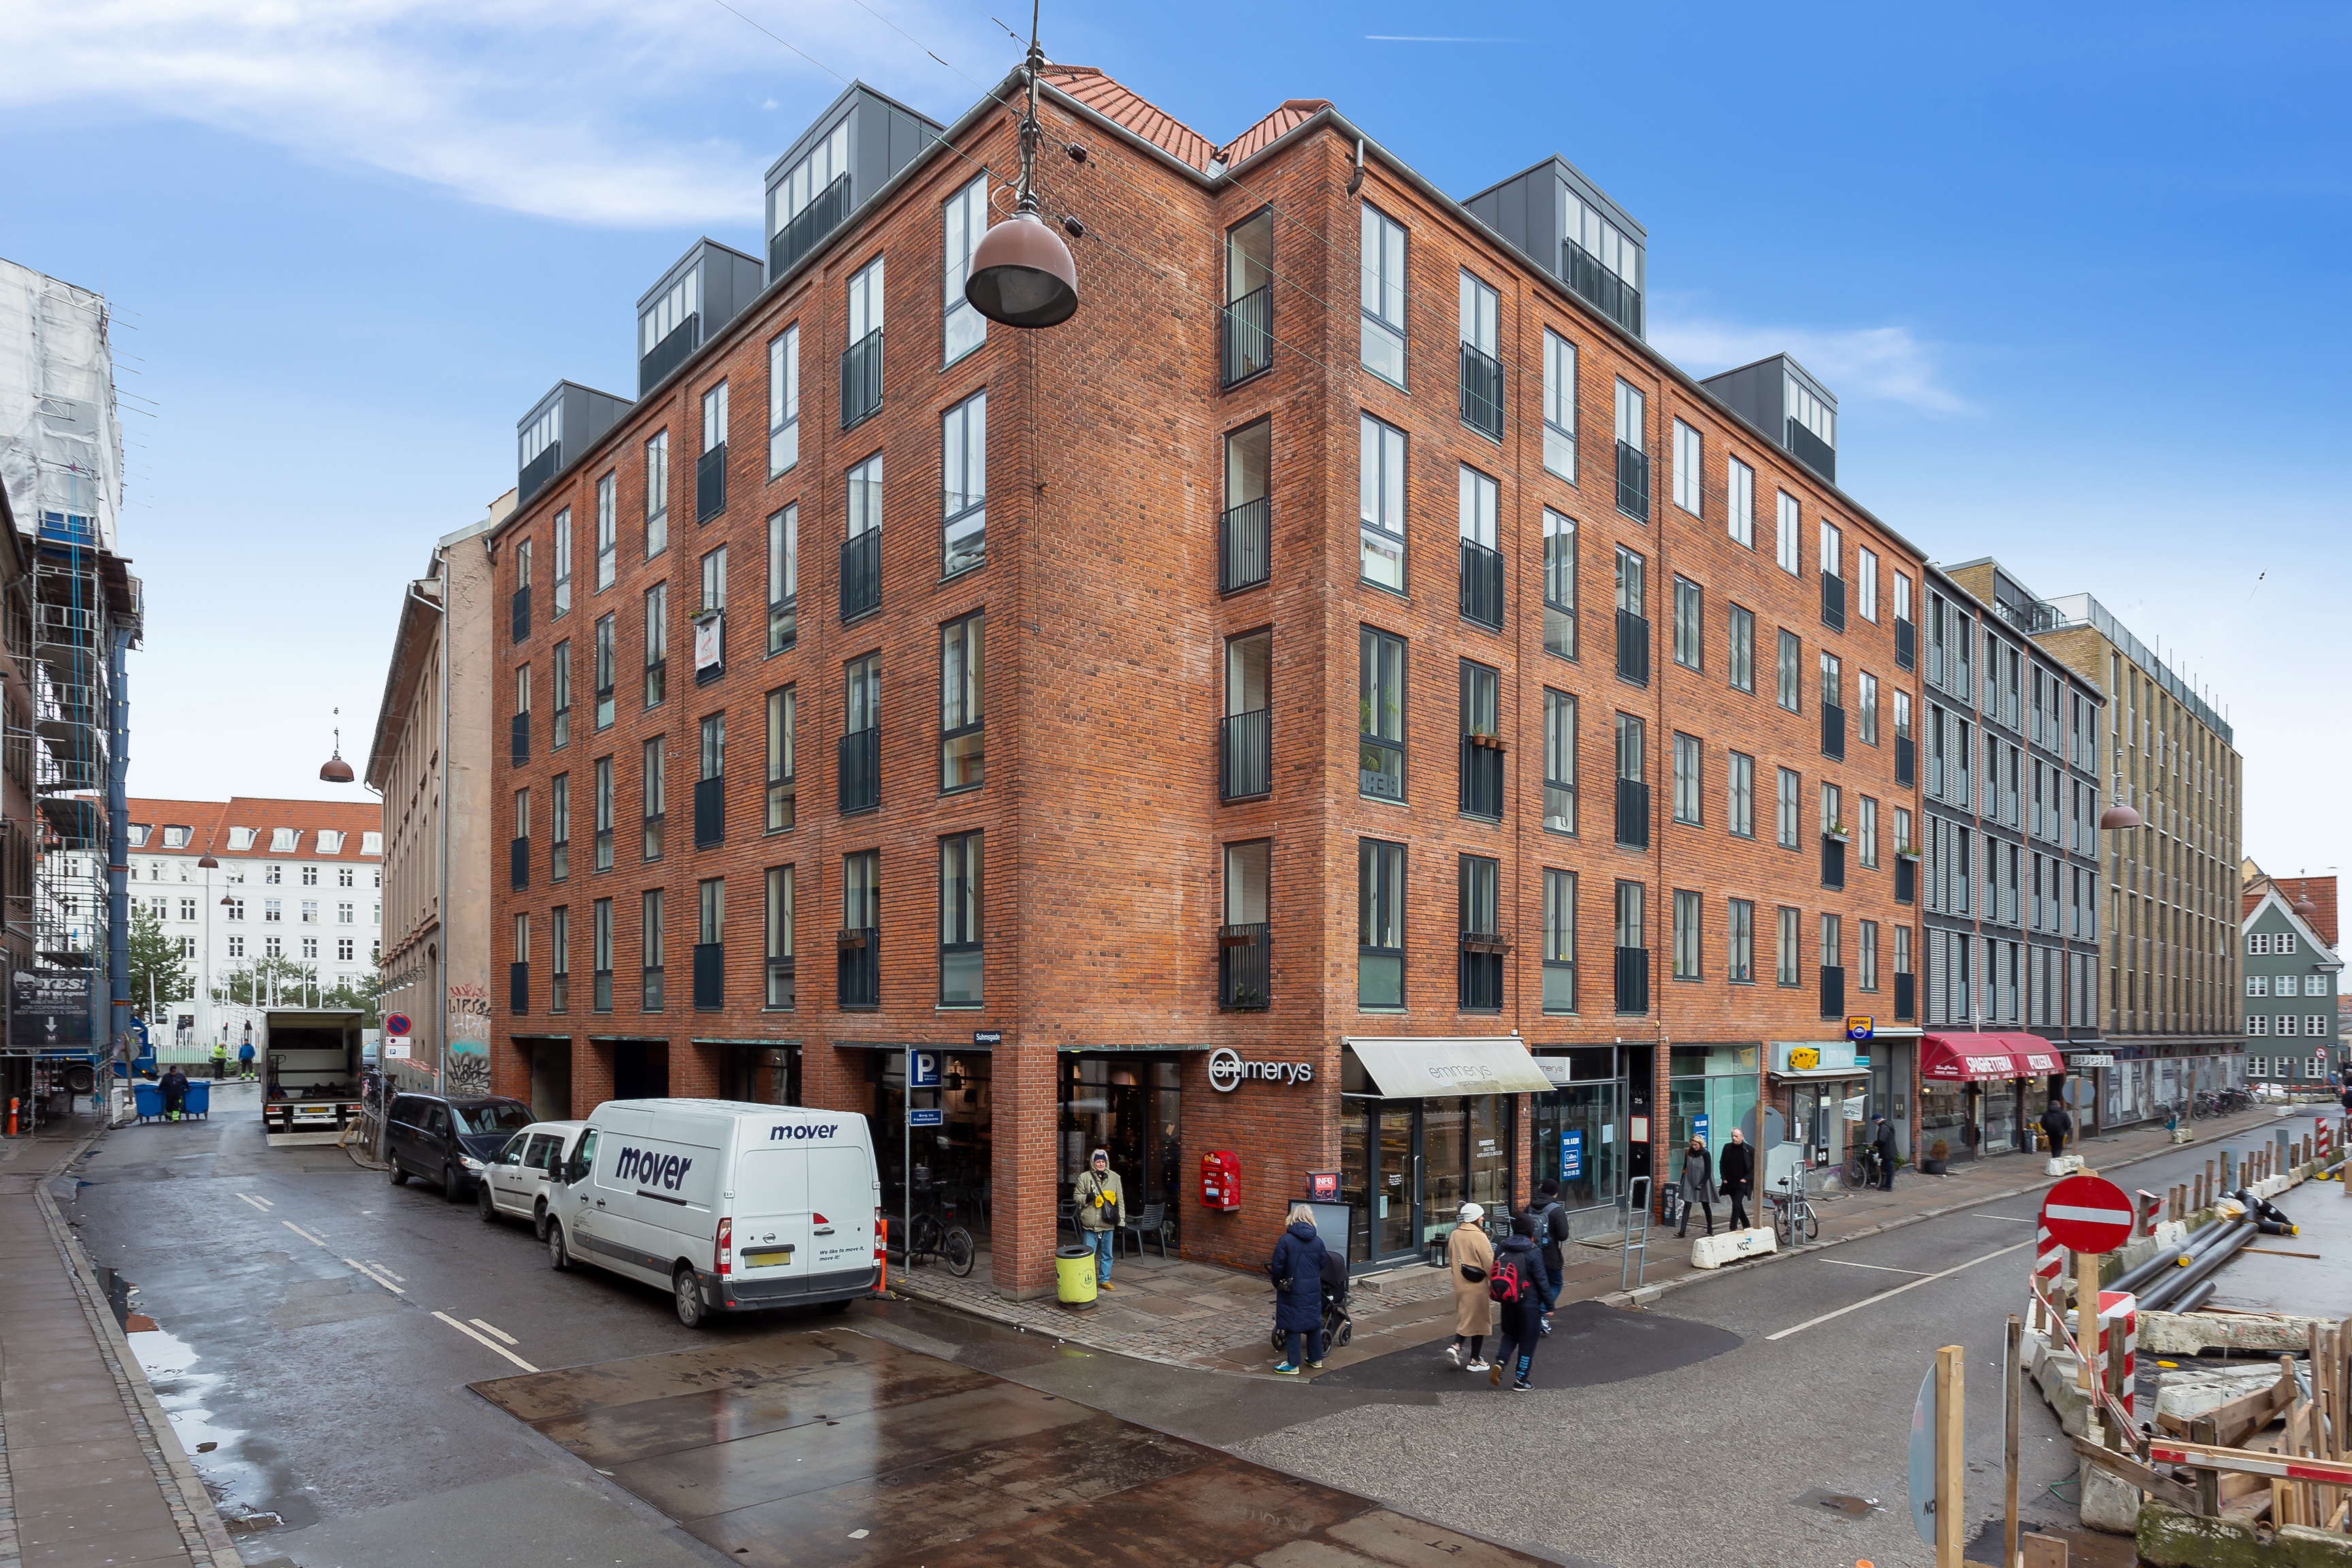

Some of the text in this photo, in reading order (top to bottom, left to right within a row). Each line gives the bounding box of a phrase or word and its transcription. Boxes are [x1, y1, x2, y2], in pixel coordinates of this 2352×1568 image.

[40, 979, 86, 990] YES!
[918, 1054, 935, 1082] P
[1965, 1056, 2014, 1073] SPAGHETTERIA
[2027, 1055, 2055, 1070] PIZZERIA
[1429, 1064, 1492, 1079] emmerys
[770, 1124, 838, 1141] mover
[615, 1146, 693, 1191] mover
[1737, 1241, 1749, 1252] NCC
